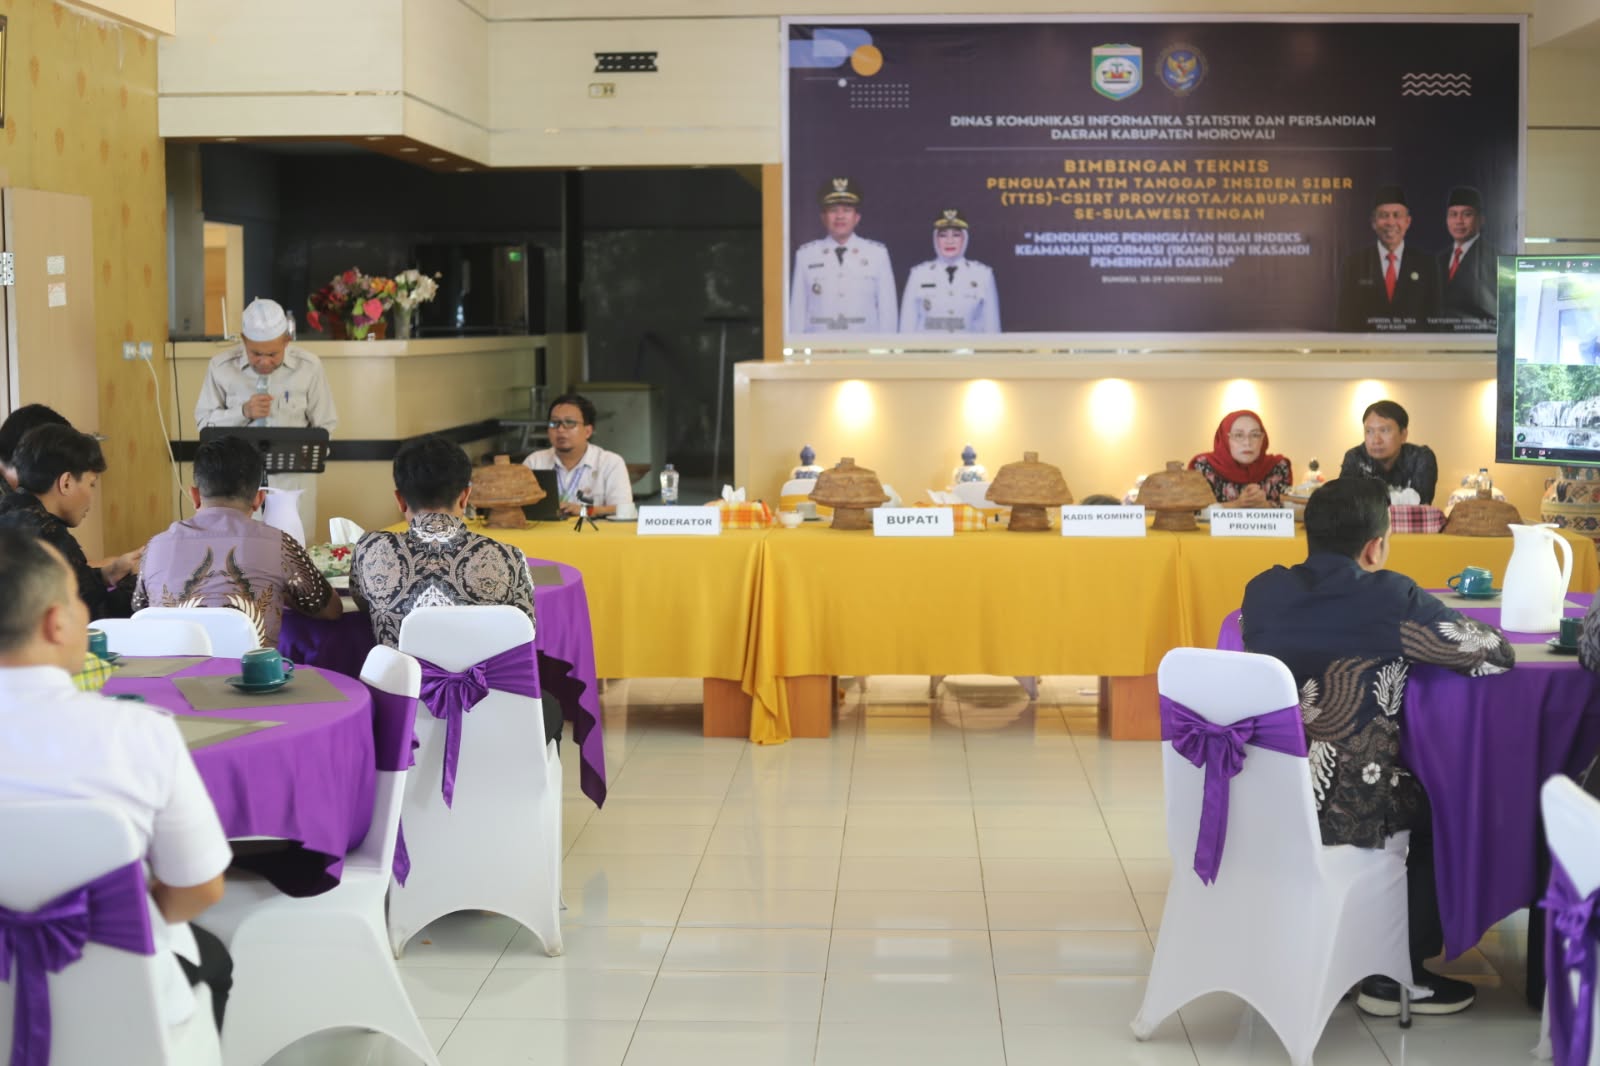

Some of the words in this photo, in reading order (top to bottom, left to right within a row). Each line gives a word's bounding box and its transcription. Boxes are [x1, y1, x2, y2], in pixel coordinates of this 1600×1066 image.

[950, 115, 993, 127] DINAS
[996, 115, 1085, 127] KOMUNIKASI
[1088, 115, 1183, 127] INFORMATIKA
[1186, 115, 1251, 127] STATISTIK
[1255, 115, 1285, 127] DAN
[1289, 115, 1376, 127] PERSANDIAN
[1051, 129, 1108, 140] DAERAH
[1112, 129, 1193, 140] KABUPATEN
[1197, 129, 1275, 140] MOROWALI
[1064, 159, 1188, 173] BIMBINGAN
[1195, 159, 1270, 173] TEKNIS
[987, 178, 1091, 190] PENGUATAN
[1097, 178, 1128, 190] TIM
[1134, 178, 1217, 190] TANGGAP
[1223, 178, 1296, 190] INSIDEN
[1303, 178, 1353, 190] SIBER
[1001, 192, 1113, 206] (TTIS)-CSIRT
[1120, 192, 1333, 205] PROV/KOTA/KABUPATEN
[1074, 208, 1190, 220] SE-SULAWESI
[1197, 208, 1265, 220] TENGAH
[1034, 232, 1119, 243] MENDUKUNG
[1122, 232, 1214, 243] PENINGKATAN
[1218, 232, 1250, 243] NILAI
[1254, 232, 1301, 243] INDEKS
[1015, 244, 1089, 256] KEAMANAN
[1092, 244, 1164, 256] INFORMASI
[1216, 244, 1245, 256] DAN
[1091, 257, 1172, 268] PEMERINTAH
[887, 515, 939, 525] BUPATI
[1096, 513, 1143, 521] KOMINFO
[1213, 511, 1243, 519] KADIS
[1246, 511, 1293, 520] KOMINFO
[645, 518, 712, 527] MODERATOR
[1229, 523, 1277, 531] PROVINSI
